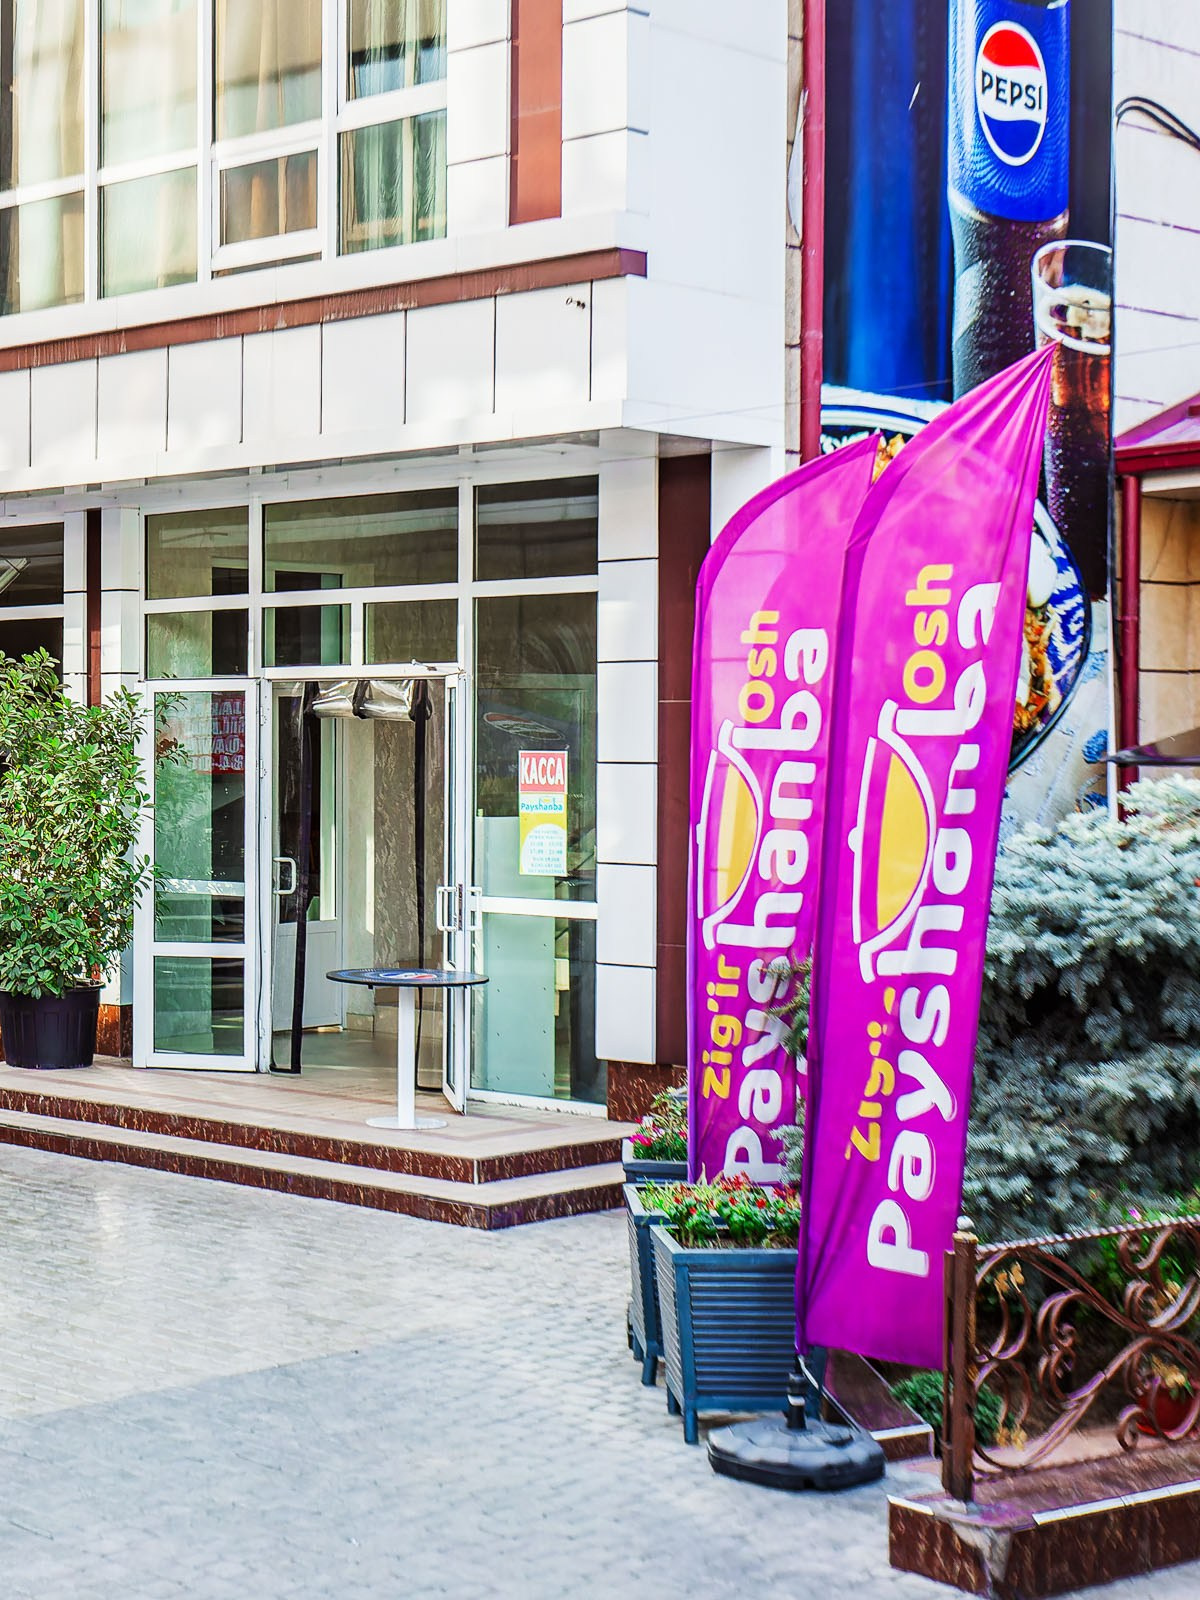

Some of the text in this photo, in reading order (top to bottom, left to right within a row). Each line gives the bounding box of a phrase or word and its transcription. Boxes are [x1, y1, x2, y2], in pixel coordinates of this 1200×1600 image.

[981, 68, 1042, 110] PEPSI
[738, 610, 780, 724] Osh
[902, 563, 954, 704] Osh
[521, 757, 564, 785] КАССА
[521, 799, 563, 812] Payshanba
[716, 627, 829, 1184] Payshanba
